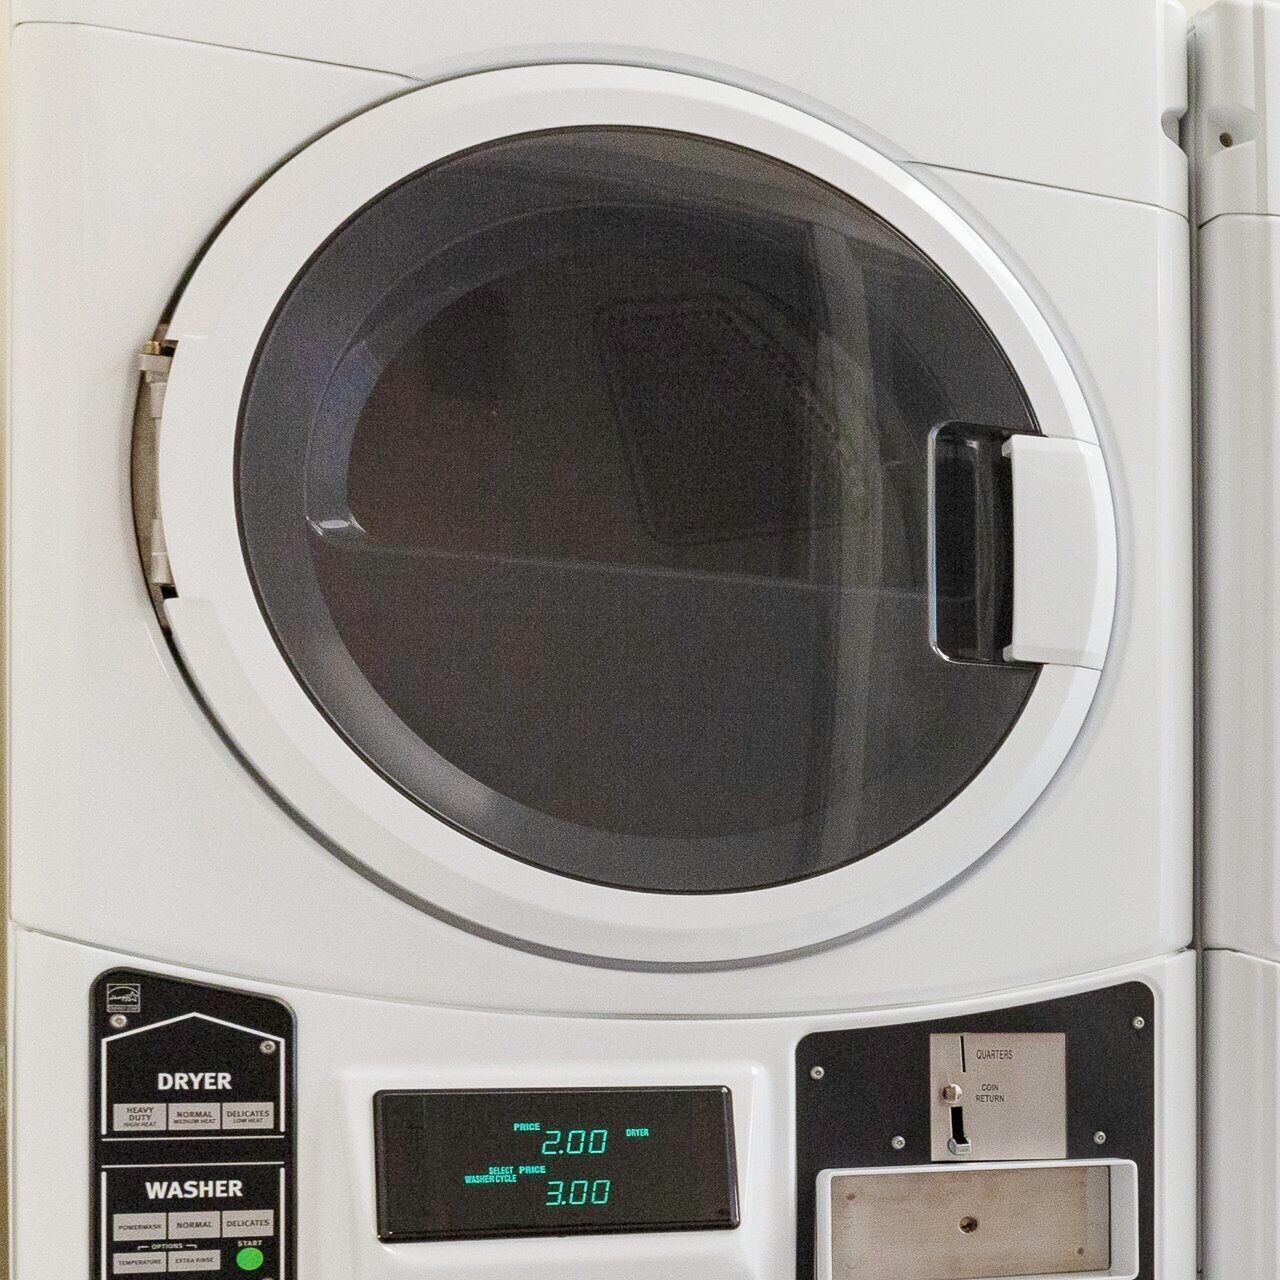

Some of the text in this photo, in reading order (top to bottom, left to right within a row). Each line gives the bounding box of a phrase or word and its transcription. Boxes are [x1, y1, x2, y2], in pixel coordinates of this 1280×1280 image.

[976, 1049, 1013, 1059] QUARTERS
[158, 1072, 232, 1090] DRYER
[227, 1110, 269, 1118] DELICATES
[513, 1123, 541, 1131] PRICE
[626, 1128, 649, 1137] DRYER
[541, 1129, 608, 1155] 2.00
[488, 1166, 546, 1175] SELECT PRICE
[464, 1174, 517, 1183] WASHER CYCLE
[145, 1180, 243, 1199] WASHER
[545, 1180, 610, 1205] 3.00
